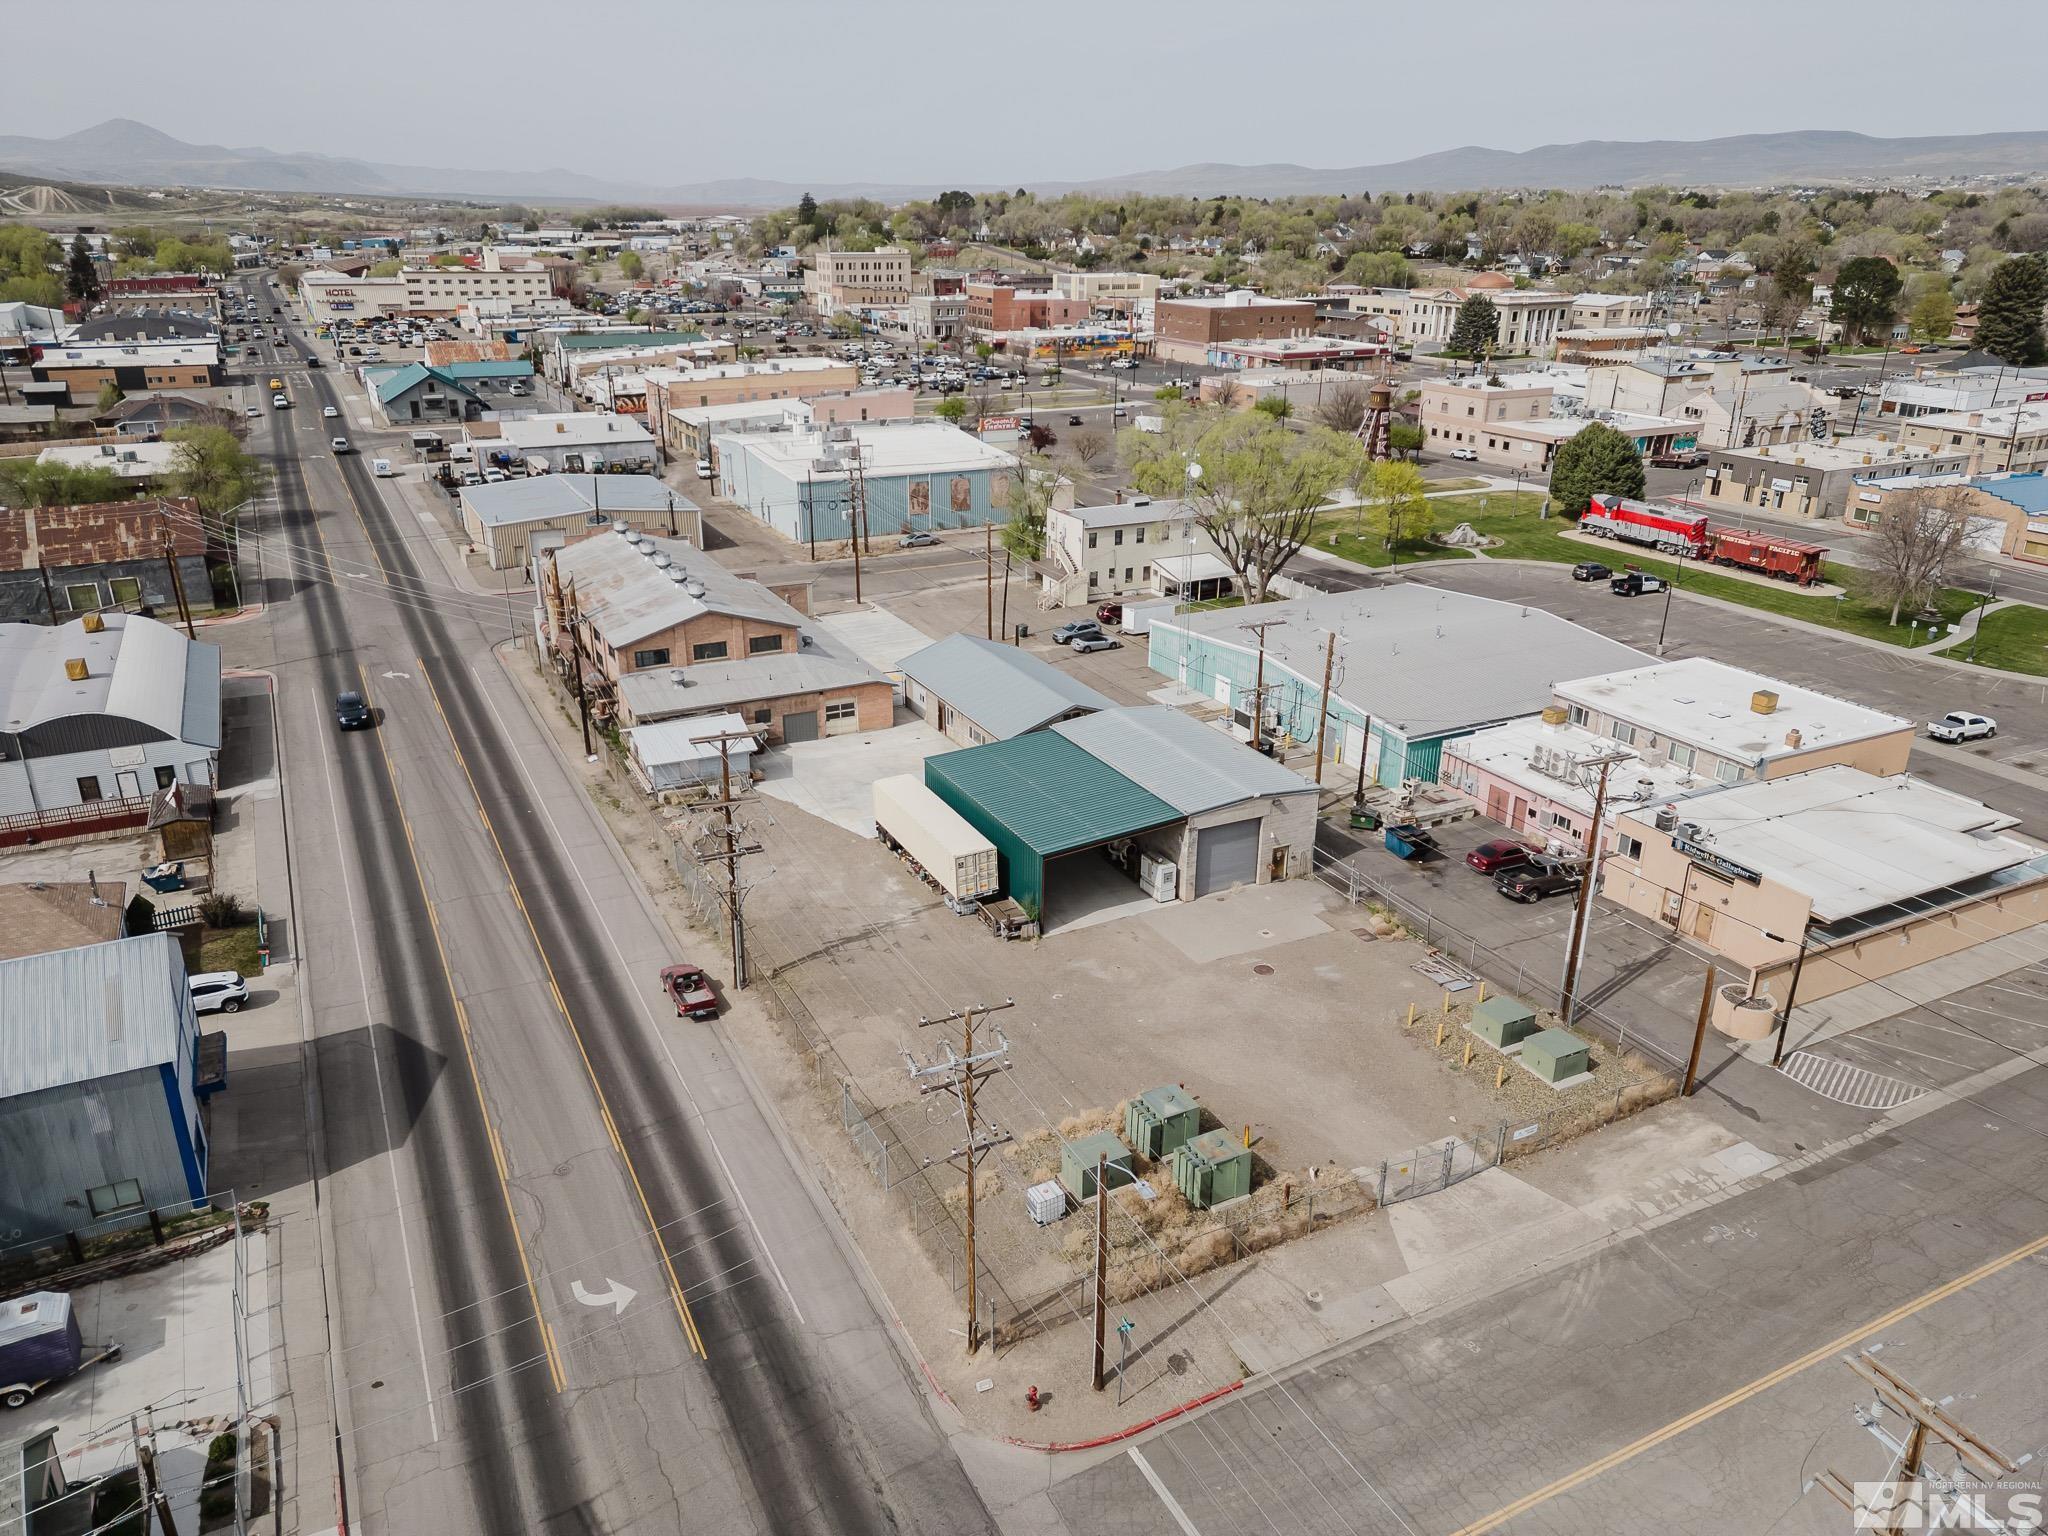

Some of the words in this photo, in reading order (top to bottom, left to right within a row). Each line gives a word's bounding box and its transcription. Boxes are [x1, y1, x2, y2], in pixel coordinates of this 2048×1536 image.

[984, 416, 1017, 425] Crystal
[1720, 534, 1751, 546] WESTERN
[1769, 545, 1800, 557] PACIFIC
[1684, 843, 1709, 860] Kidwell
[1716, 858, 1750, 877] Gallagher
